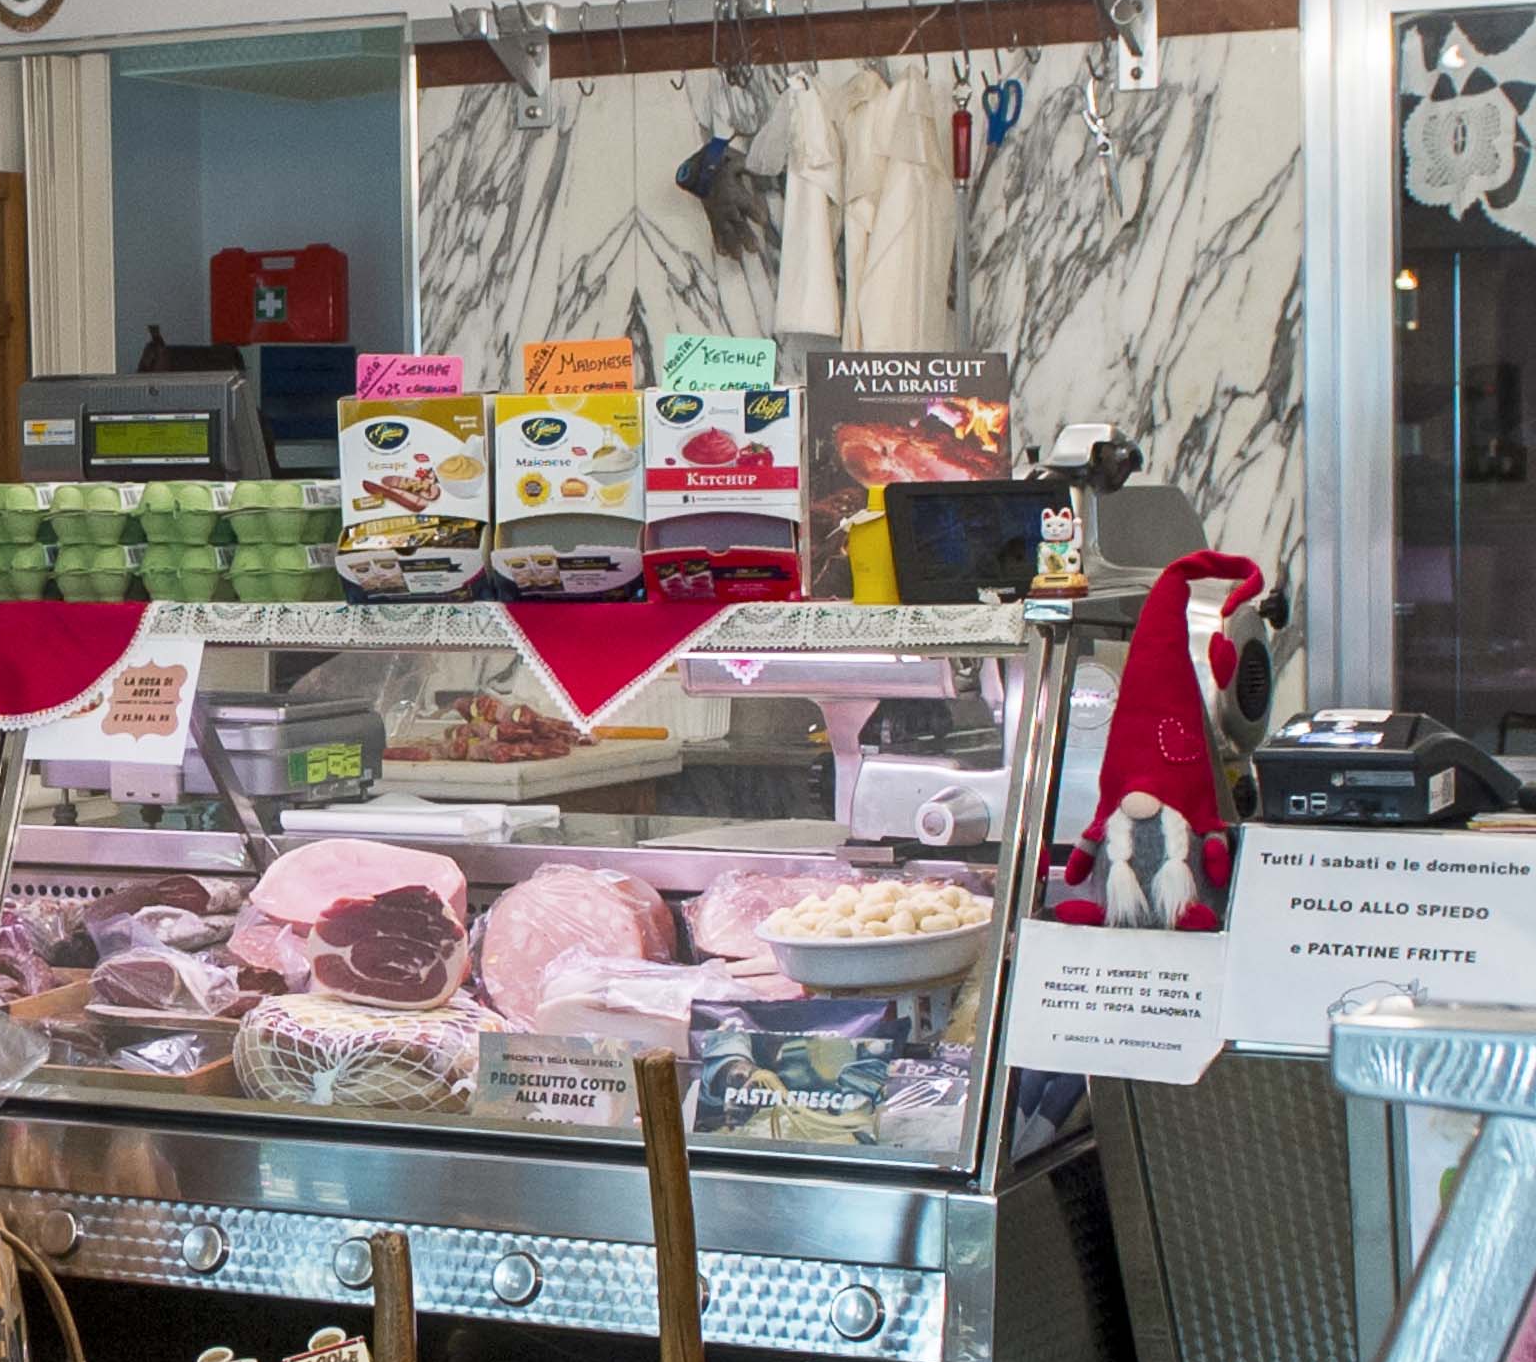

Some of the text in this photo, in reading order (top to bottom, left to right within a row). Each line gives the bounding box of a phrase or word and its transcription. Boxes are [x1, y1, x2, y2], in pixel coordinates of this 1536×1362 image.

[556, 353, 632, 375] MAIONESE
[702, 345, 767, 367] KETCHUP
[827, 359, 986, 379] JAMBON CUIT
[854, 377, 959, 393] À LA BRAISE
[516, 457, 571, 468] Maionese
[124, 677, 135, 686] LA
[1261, 852, 1531, 876] Tutti i sabati e le domeniche
[1291, 897, 1490, 920] POLLO ALLO SPIEDO
[1290, 942, 1478, 964] e PATATINE FRITTE
[1062, 965, 1090, 975] TUTTI
[1158, 972, 1190, 982] TROTE
[1096, 985, 1133, 996] FILETTI
[1139, 988, 1151, 997] DI
[1158, 989, 1190, 999] TROTA
[1041, 998, 1201, 1019] FILETTI DI TROTA SALMONATA
[1104, 1037, 1115, 1045] LA
[490, 1071, 627, 1093] PROSCIUTTO COTTO
[515, 1091, 596, 1108] ALLA BRACE
[724, 1087, 856, 1109] PASTA FRESCA
